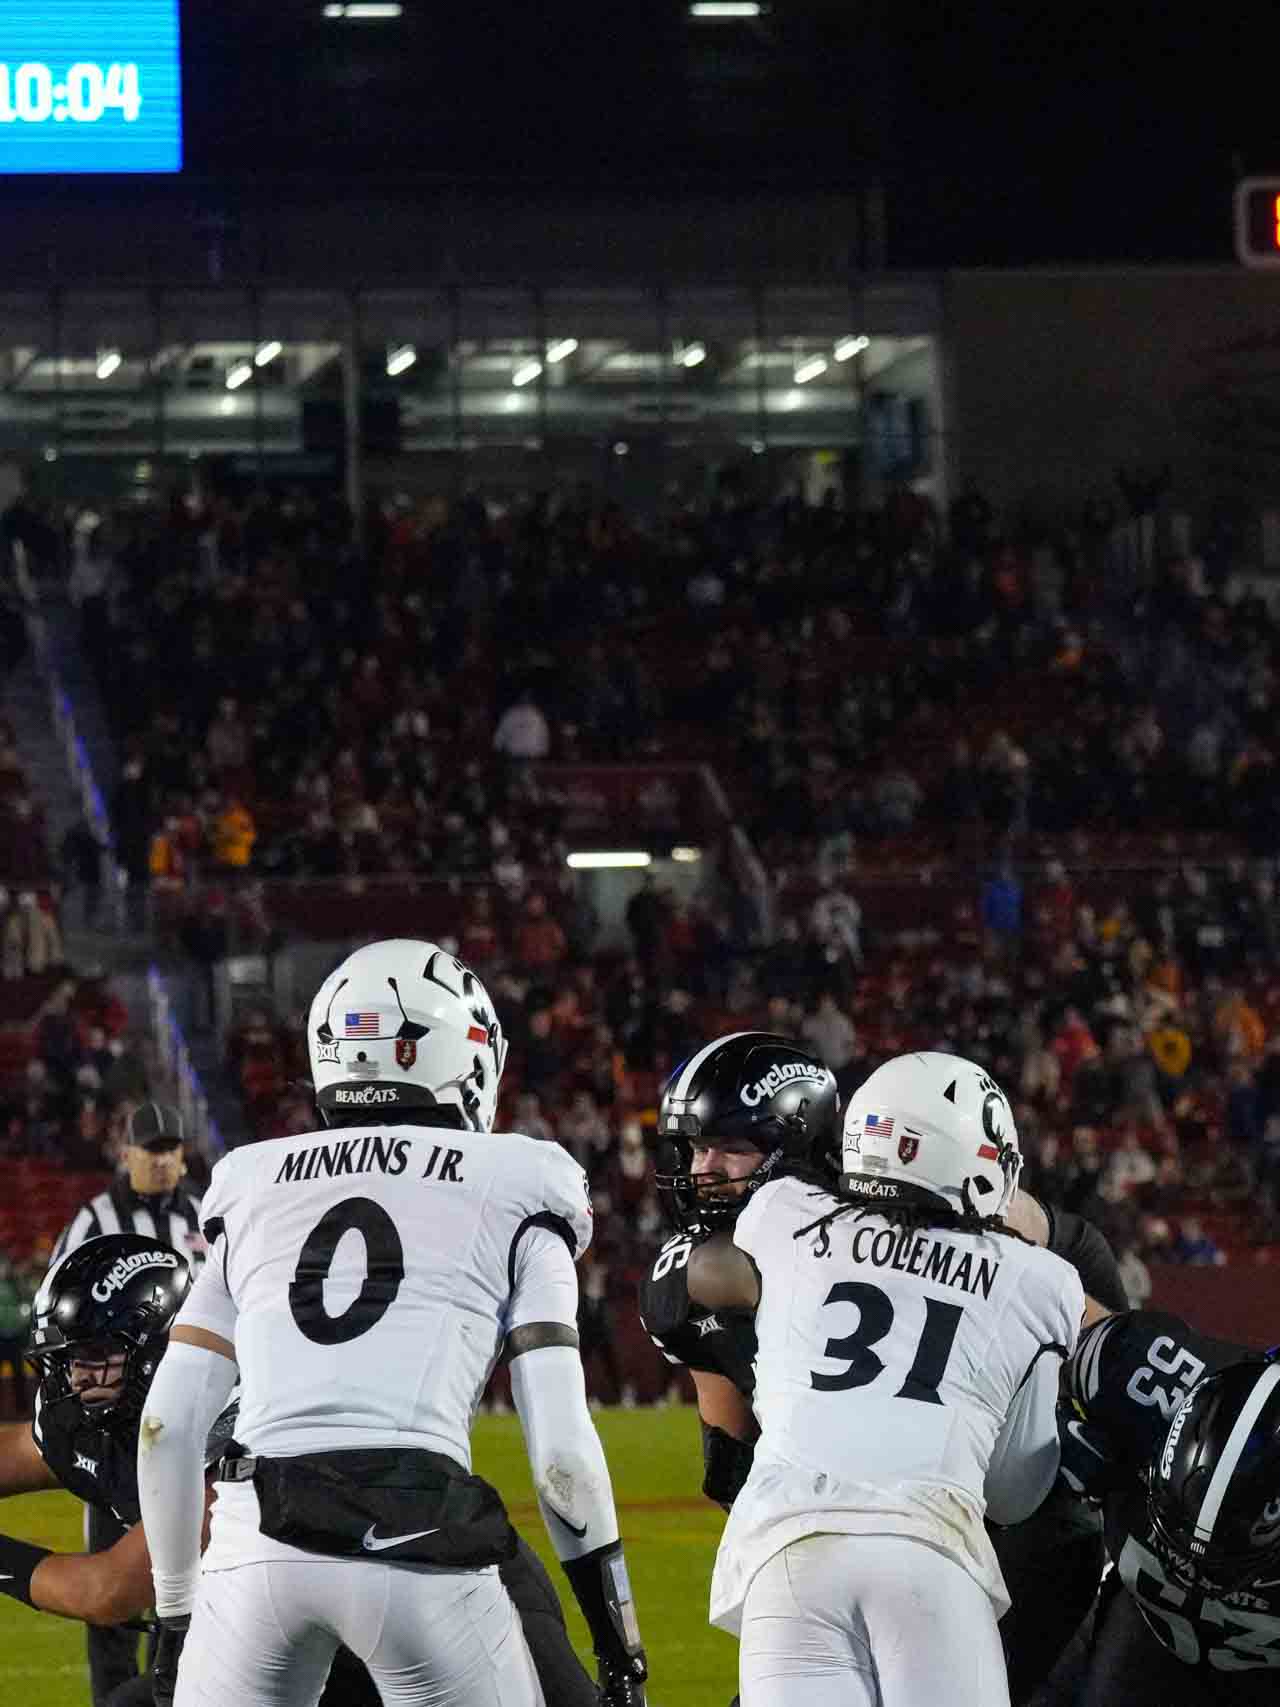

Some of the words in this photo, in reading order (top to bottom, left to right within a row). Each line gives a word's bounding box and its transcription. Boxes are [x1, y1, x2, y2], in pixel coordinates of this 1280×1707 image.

[0, 62, 143, 123] 10:04
[739, 1063, 829, 1108] Cyclones
[274, 1136, 412, 1184] MINKINS
[421, 1145, 464, 1183] JR.
[91, 1250, 178, 1303] Cyclones
[289, 1196, 406, 1346] 0
[851, 1226, 1000, 1301] COLEMAN
[810, 1281, 965, 1406] 31
